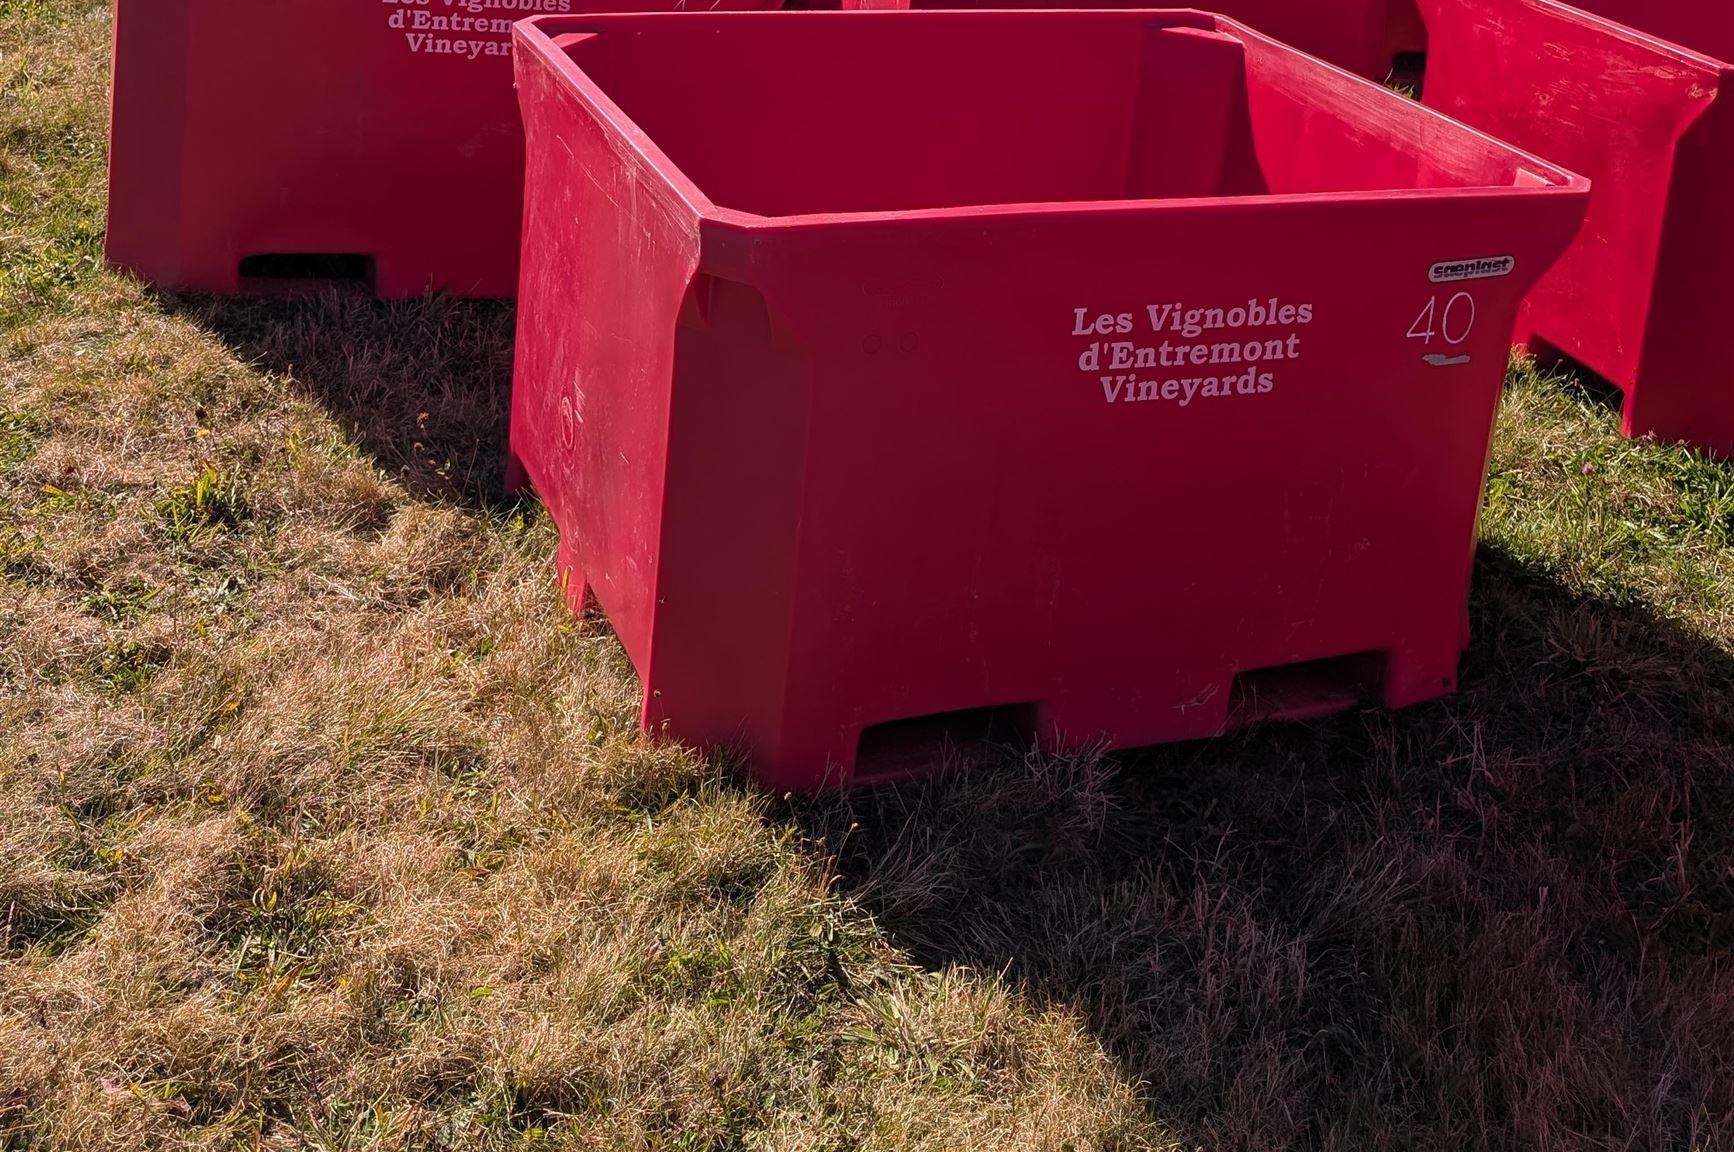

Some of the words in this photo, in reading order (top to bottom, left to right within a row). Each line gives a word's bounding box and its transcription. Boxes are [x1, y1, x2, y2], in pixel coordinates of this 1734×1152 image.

[388, 8, 514, 34] d'Entrem
[405, 33, 513, 60] Vineyar
[1072, 307, 1134, 336] Les
[1146, 297, 1313, 338] Vignobles
[1406, 291, 1476, 345] 40
[1078, 333, 1300, 372] d'Entremont
[1100, 366, 1275, 407] Vineyards
